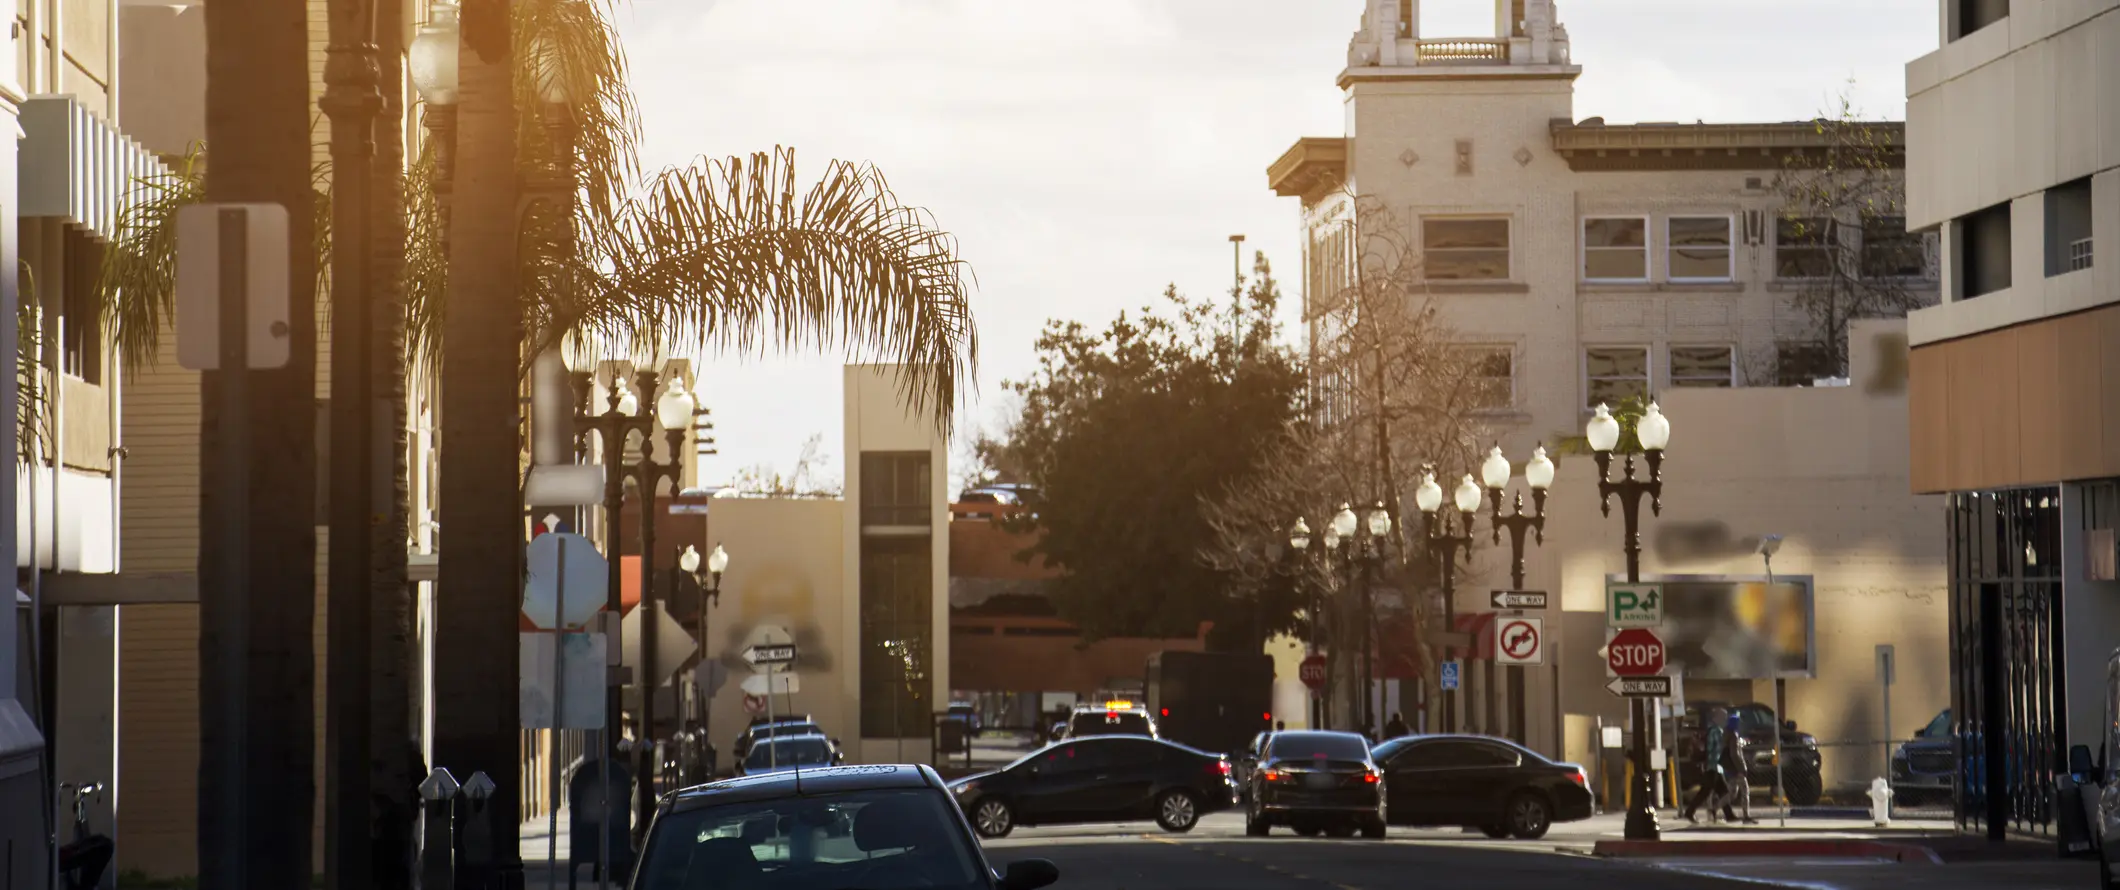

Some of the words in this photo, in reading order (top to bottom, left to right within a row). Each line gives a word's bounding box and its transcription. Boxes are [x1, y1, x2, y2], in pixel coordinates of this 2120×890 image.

[1506, 595, 1521, 605] ONE
[1526, 595, 1544, 605] WAY
[755, 650, 771, 660] ONE
[774, 648, 789, 658] WAY
[1612, 644, 1660, 667] STOP
[1302, 664, 1325, 680] STO
[1623, 681, 1641, 691] ONE
[1645, 681, 1663, 691] WAY
